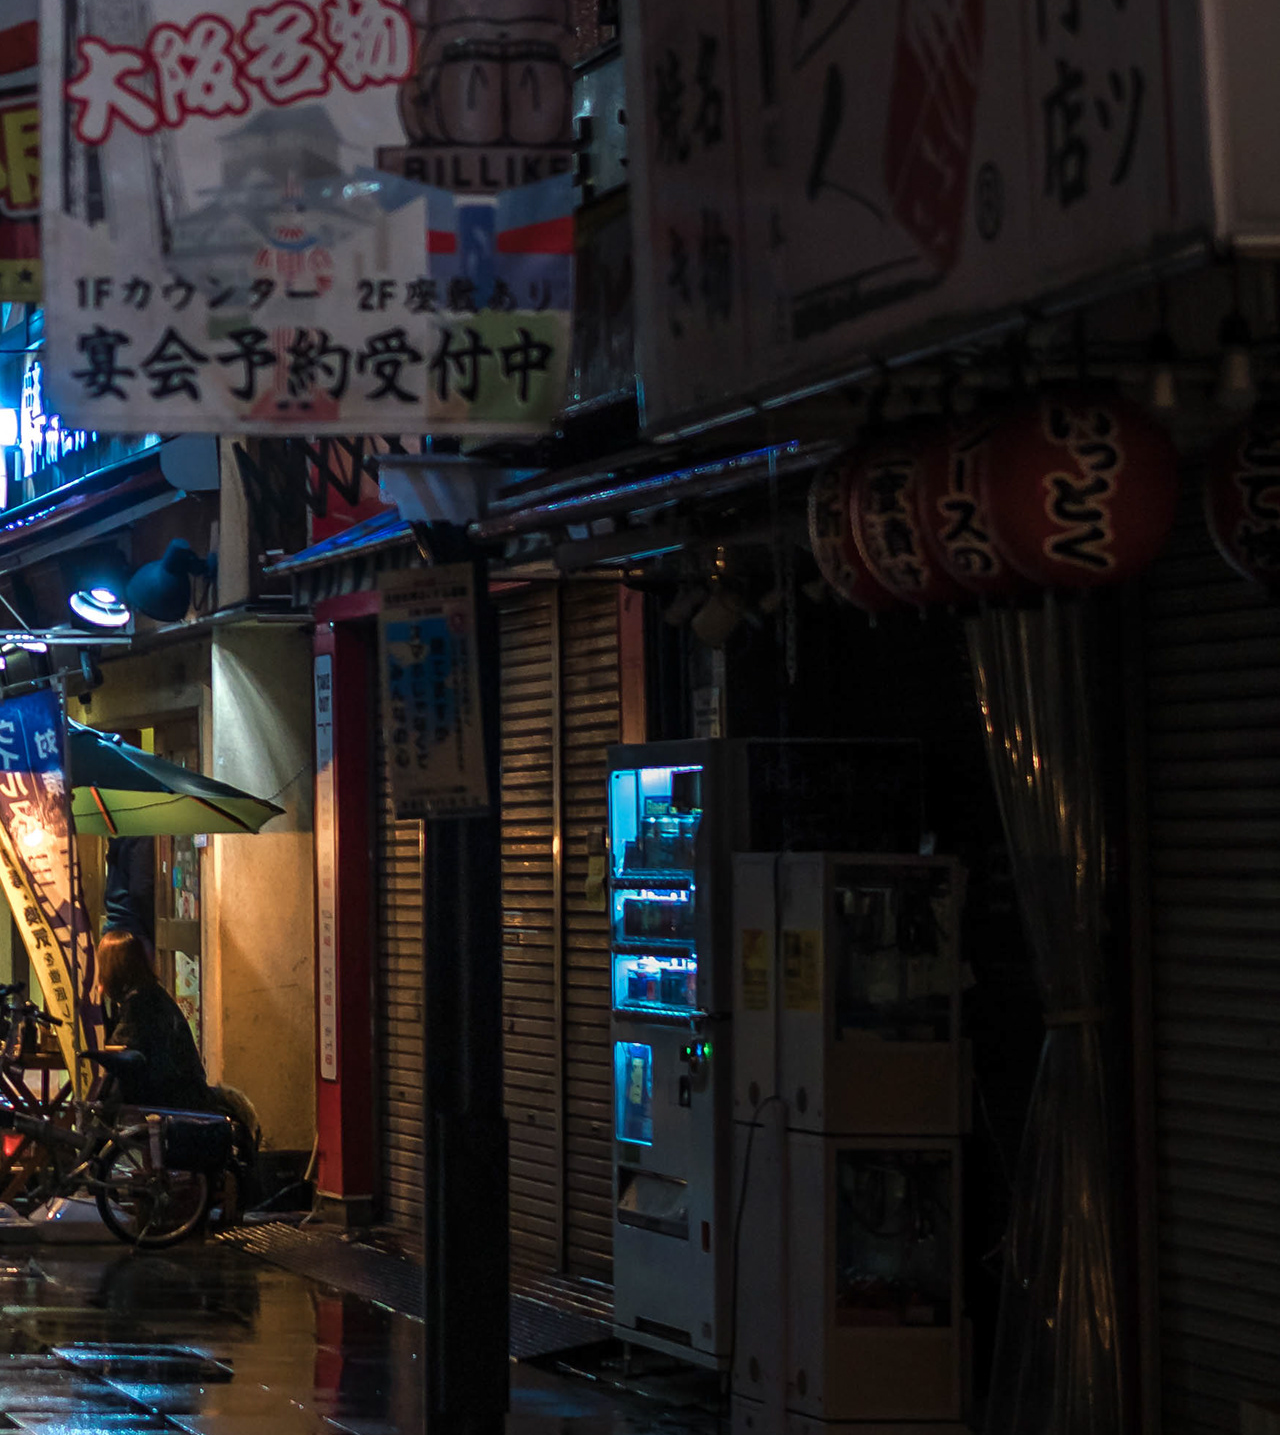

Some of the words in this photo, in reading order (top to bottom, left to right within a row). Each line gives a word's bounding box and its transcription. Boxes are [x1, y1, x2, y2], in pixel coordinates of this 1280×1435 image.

[72, 327, 555, 403] 宴会予約受付中
